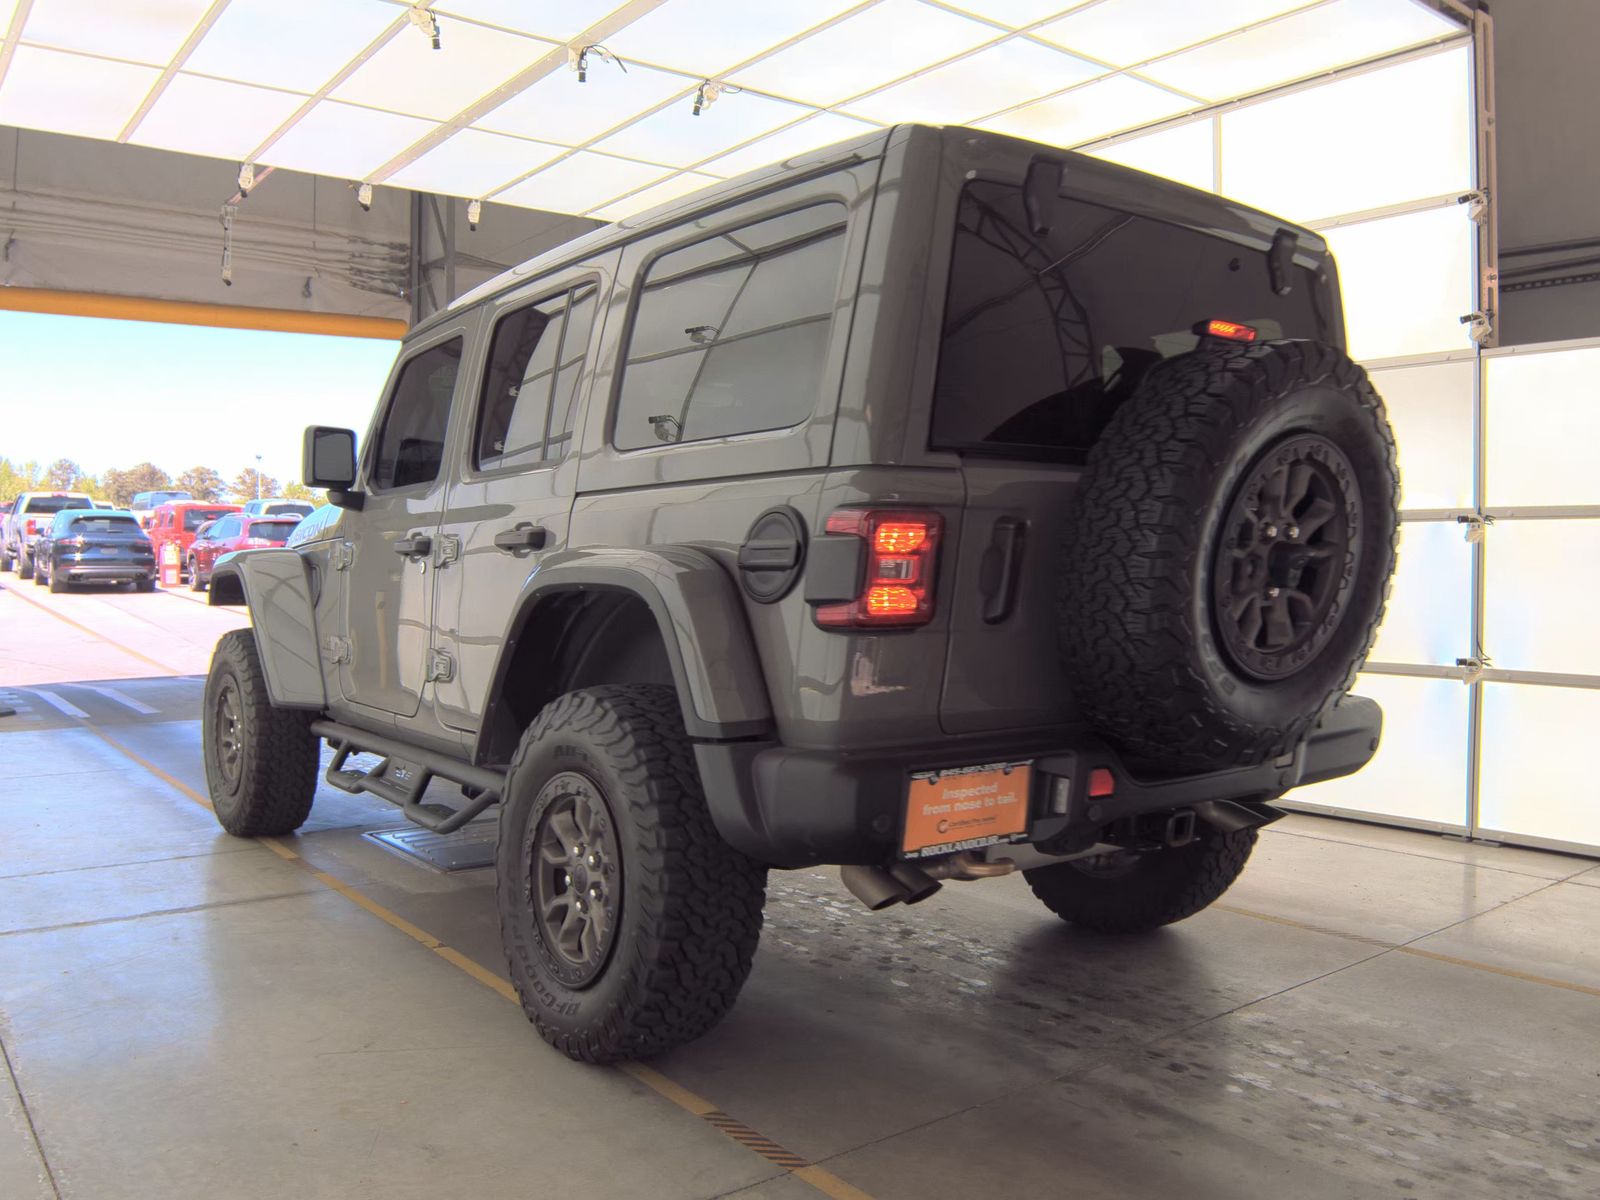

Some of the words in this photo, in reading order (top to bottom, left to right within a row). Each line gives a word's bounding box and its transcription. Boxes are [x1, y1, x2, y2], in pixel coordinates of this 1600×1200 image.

[942, 783, 998, 800] Inspected
[922, 804, 951, 816] from
[954, 799, 982, 812] nose
[984, 797, 995, 808] to
